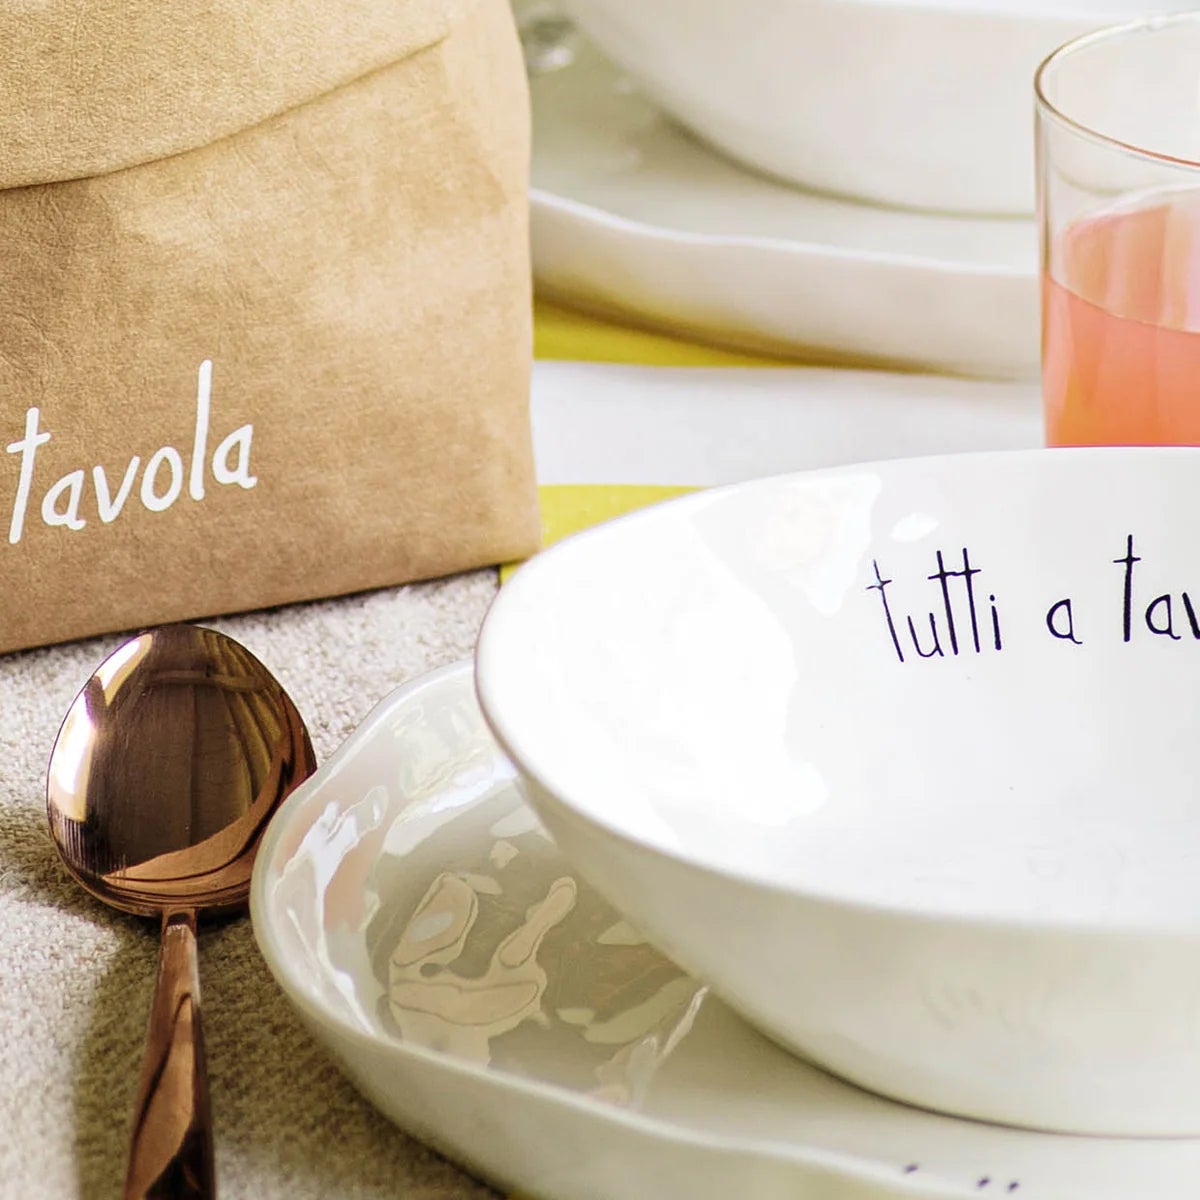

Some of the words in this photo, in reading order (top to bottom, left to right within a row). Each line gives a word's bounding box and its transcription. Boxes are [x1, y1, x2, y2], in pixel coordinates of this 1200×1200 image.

[6, 359, 258, 544] tavola
[865, 547, 1002, 663] tutti
[1046, 598, 1084, 645] a
